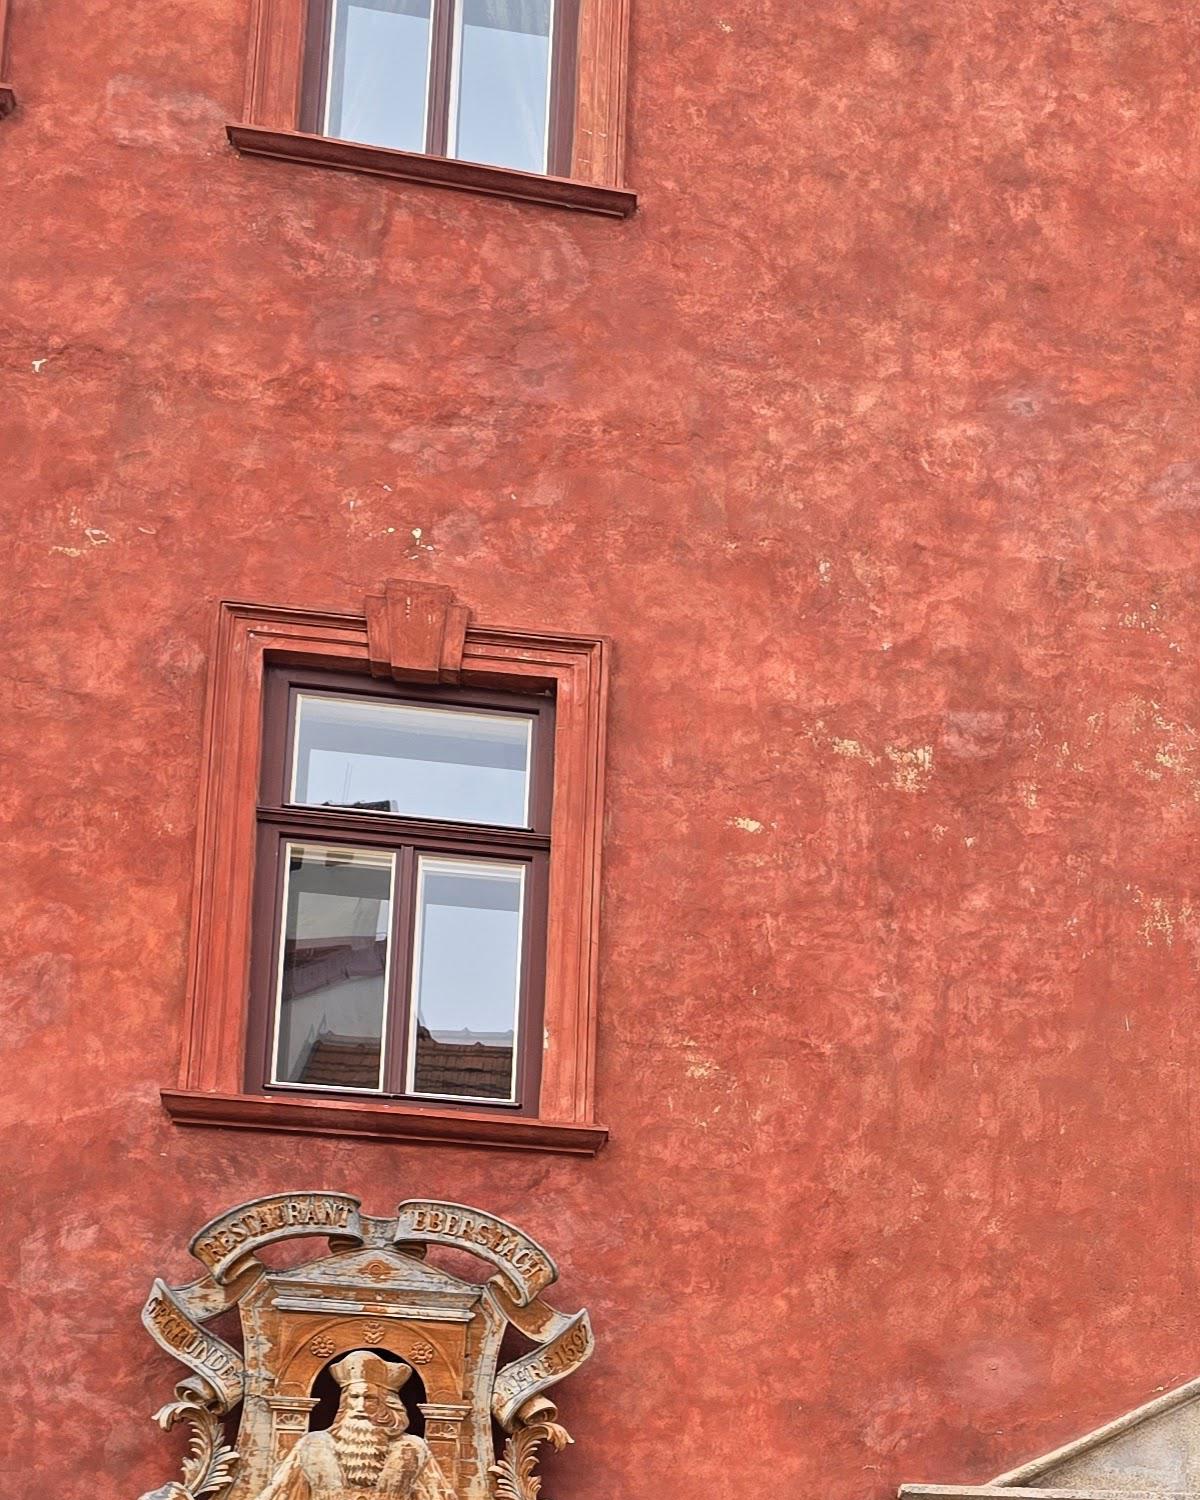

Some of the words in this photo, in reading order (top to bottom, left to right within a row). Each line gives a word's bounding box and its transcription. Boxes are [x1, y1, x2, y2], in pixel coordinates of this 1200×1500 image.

[200, 1202, 352, 1263] RESTAURANT
[411, 1210, 543, 1279] EBERSBACH
[555, 1324, 590, 1364] 1597
